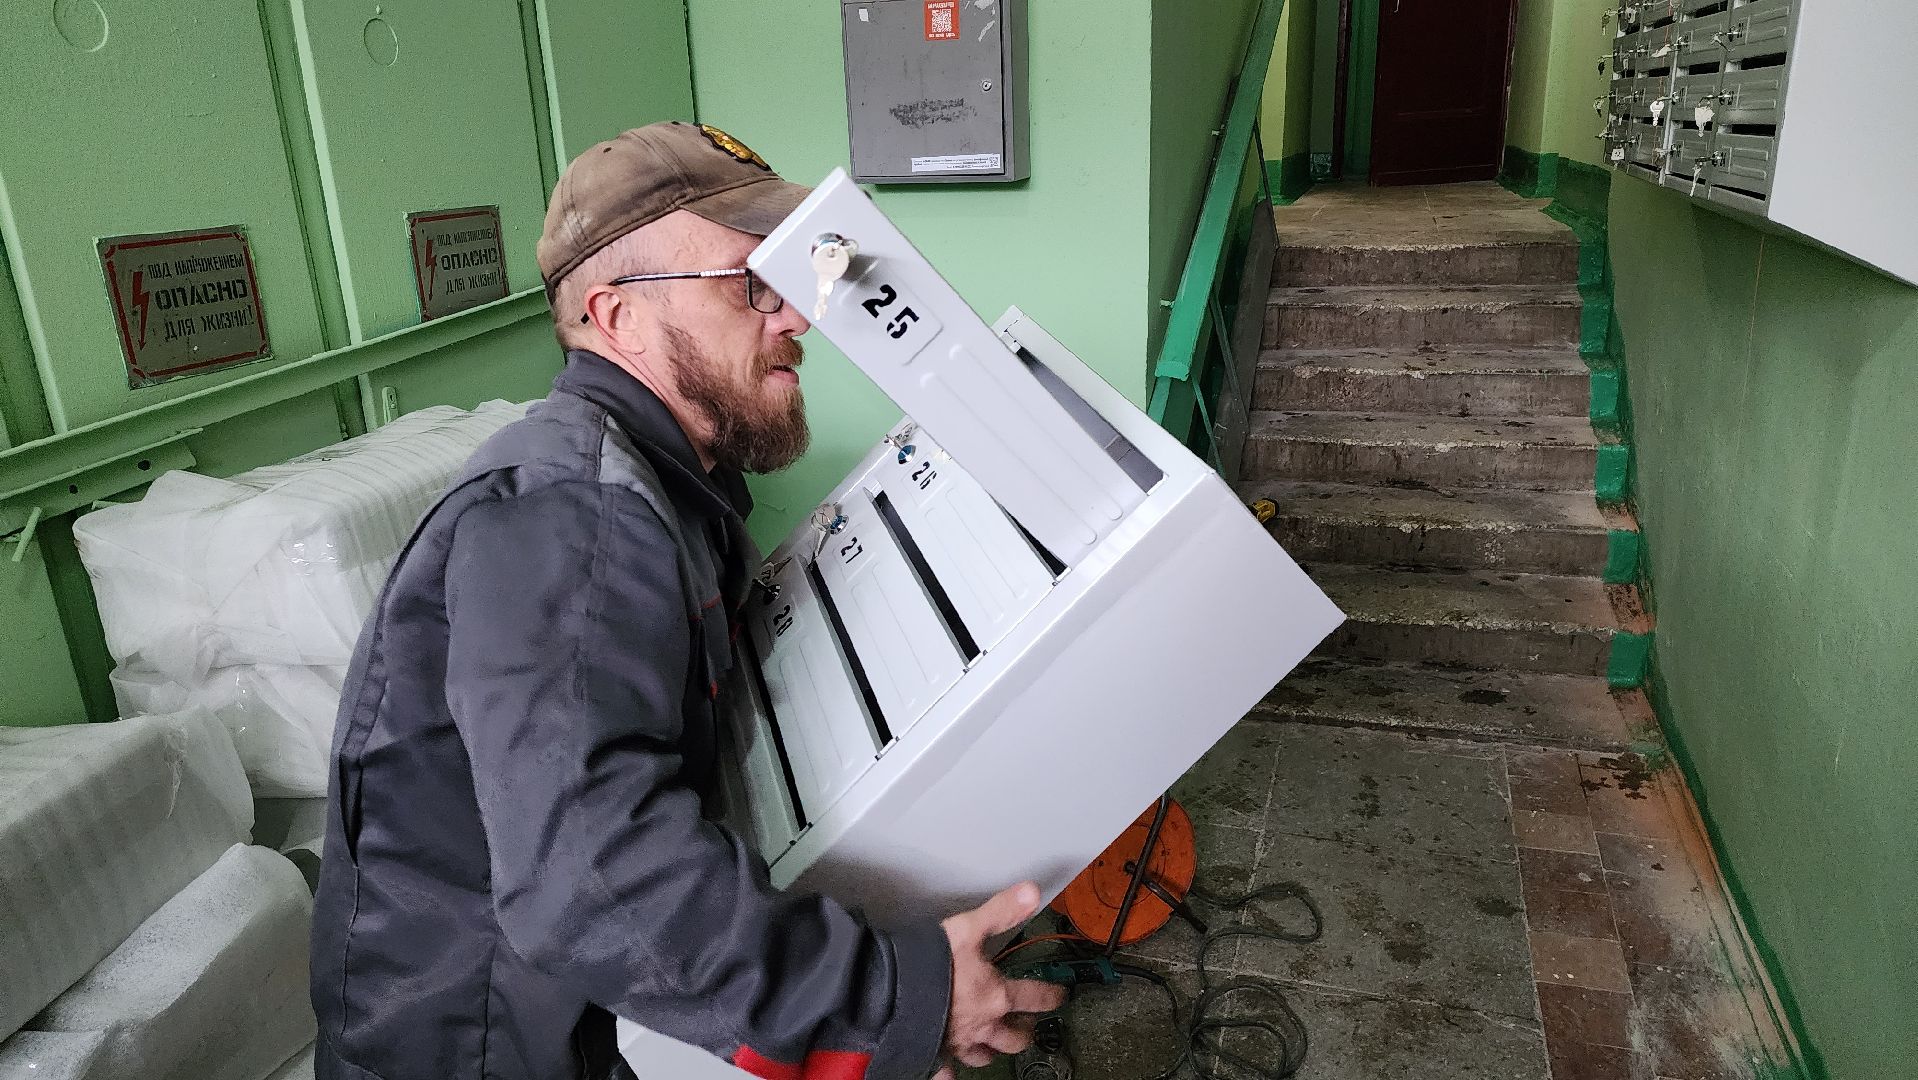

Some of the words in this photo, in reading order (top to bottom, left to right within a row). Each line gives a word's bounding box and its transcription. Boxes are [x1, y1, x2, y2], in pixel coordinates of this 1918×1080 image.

[148, 262, 172, 280] ПОД
[441, 247, 498, 270] ОПАСНО
[155, 279, 248, 311] ОПАСНО
[446, 277, 465, 295] ДЛЯ
[862, 284, 920, 339] 25
[164, 318, 196, 342] ДЛЯ
[912, 461, 937, 490] 26
[841, 536, 864, 564] 27
